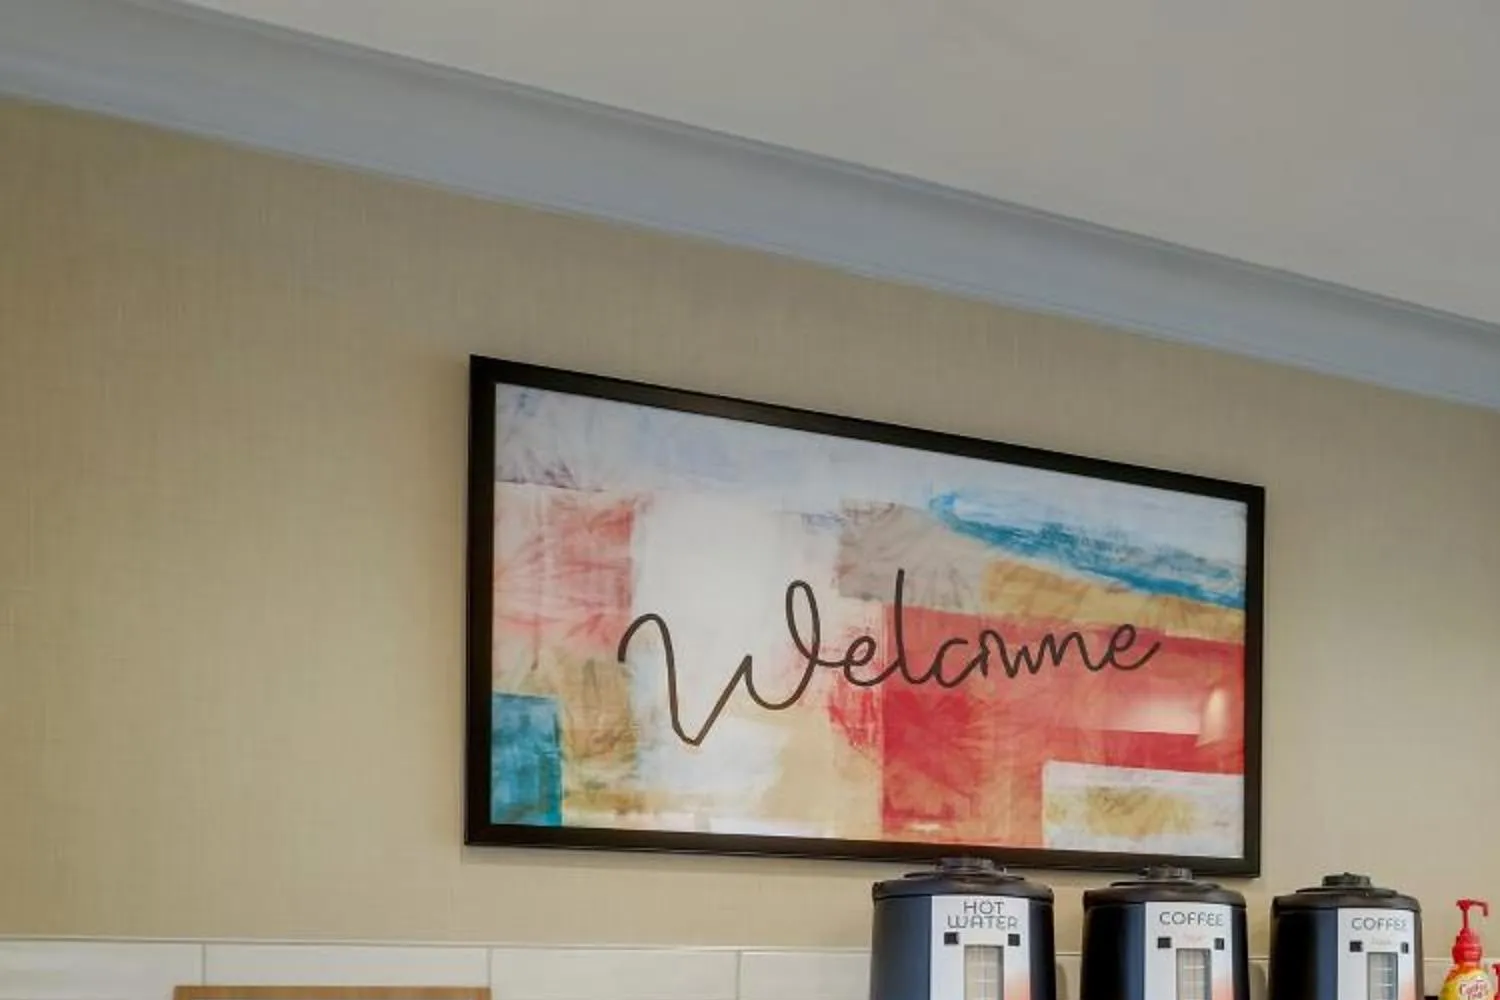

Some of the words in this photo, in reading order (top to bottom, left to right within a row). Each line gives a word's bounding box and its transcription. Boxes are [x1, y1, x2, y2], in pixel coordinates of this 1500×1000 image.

[617, 568, 1162, 747] Welcome
[963, 901, 1005, 915] HOT
[947, 914, 1018, 930] WATER
[1159, 911, 1225, 927] COFFEE
[1351, 917, 1407, 931] COFFEE
